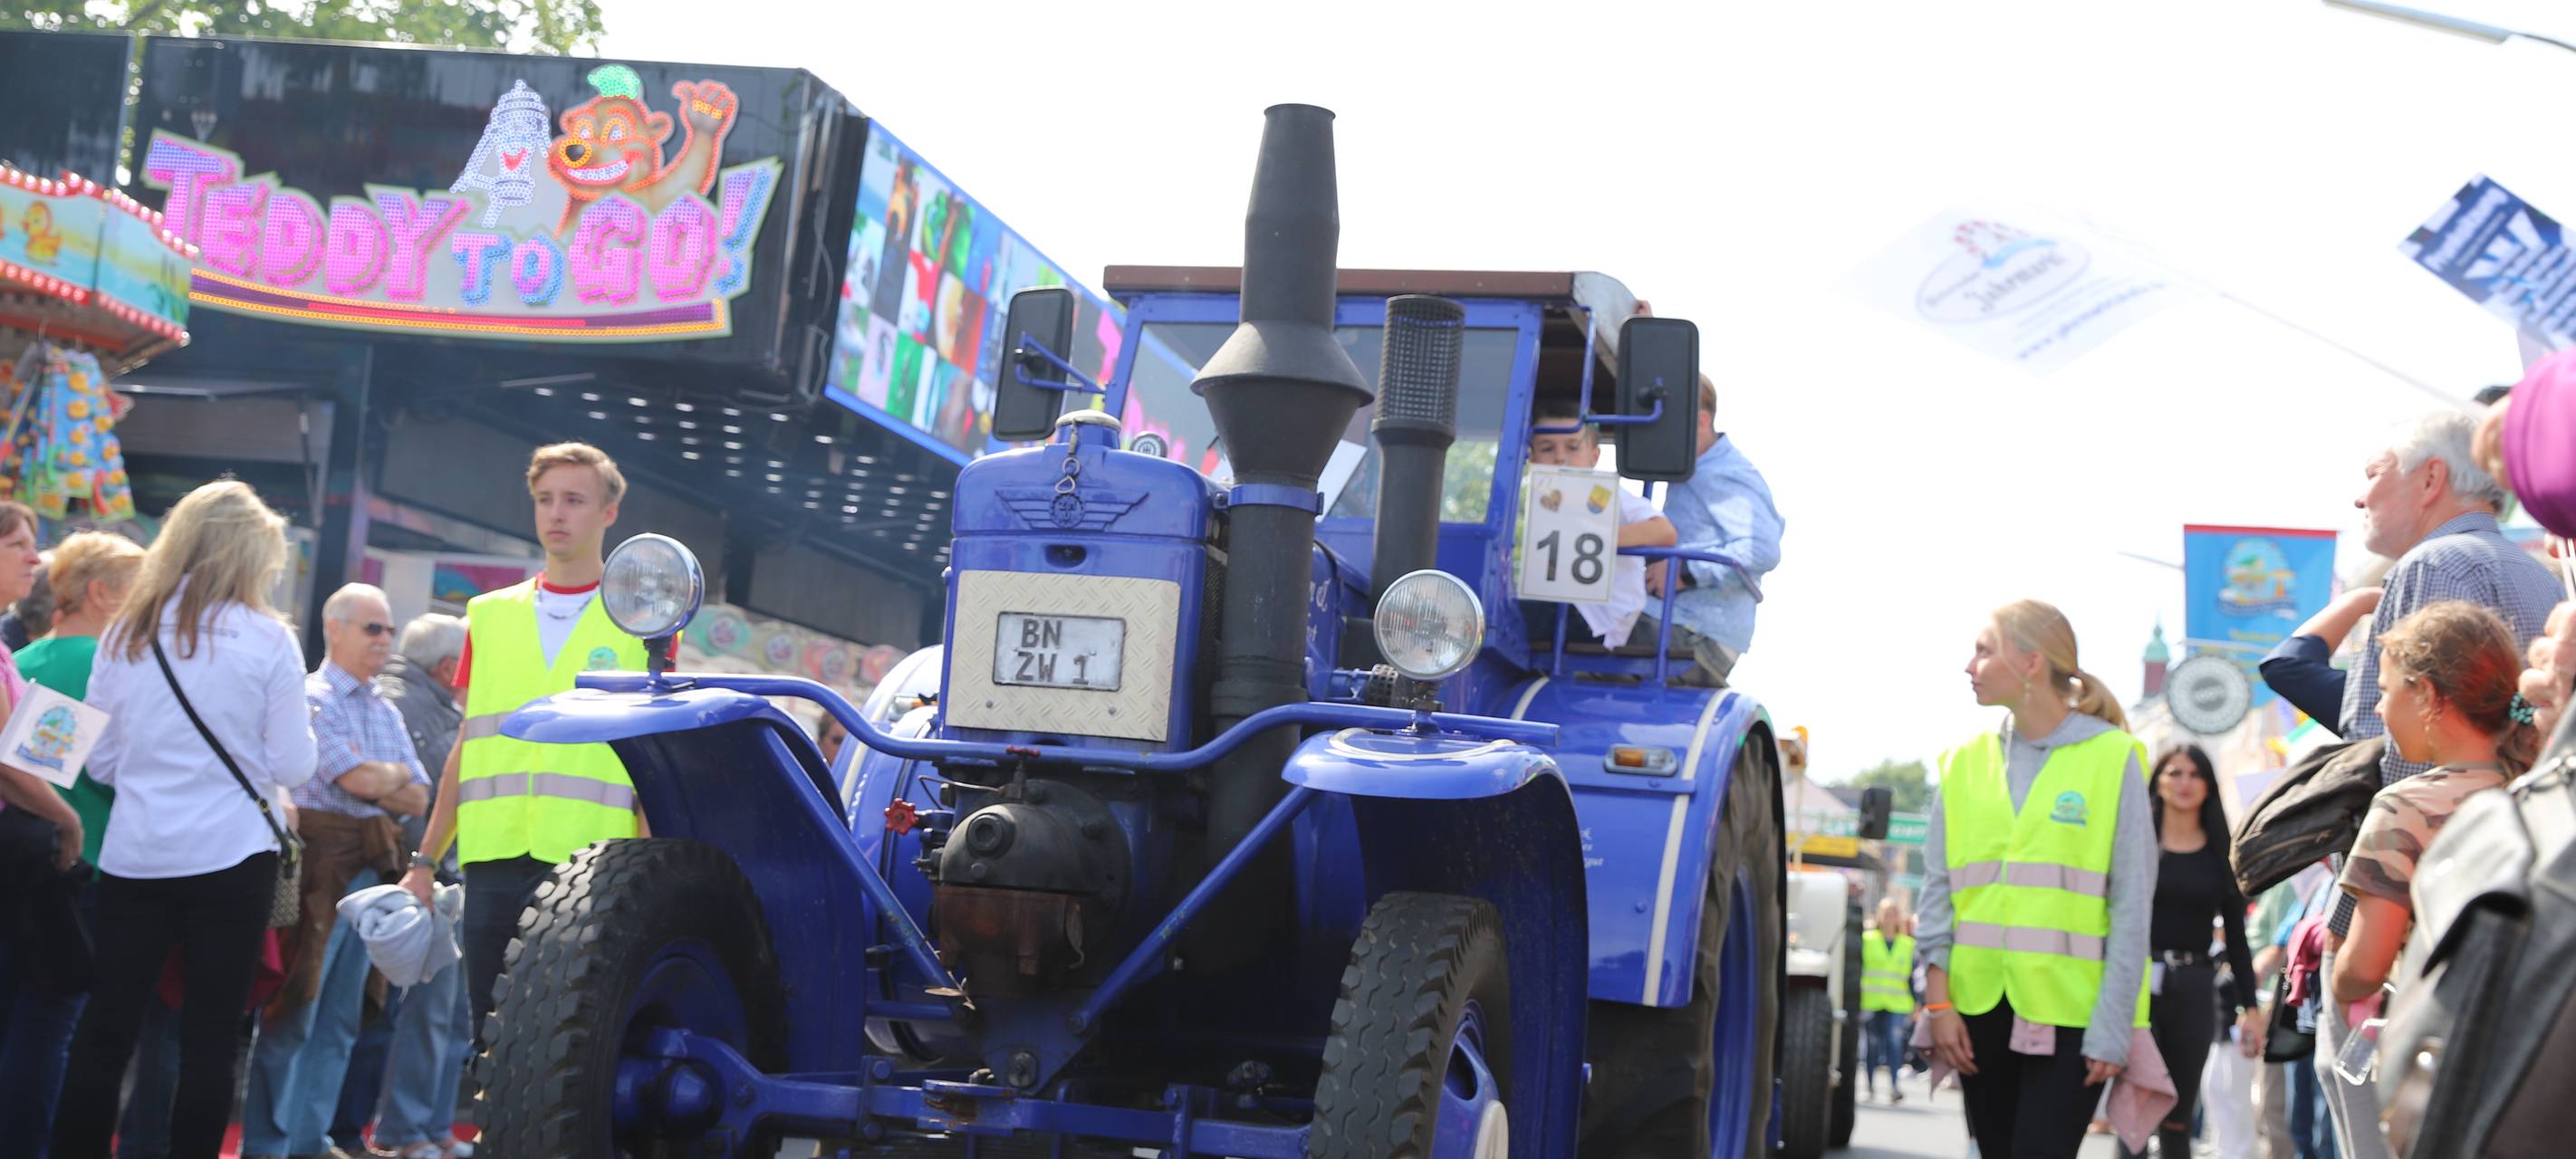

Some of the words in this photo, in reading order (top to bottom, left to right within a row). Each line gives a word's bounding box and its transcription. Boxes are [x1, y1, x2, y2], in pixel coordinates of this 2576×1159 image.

[146, 138, 468, 303] TEDDY
[452, 232, 565, 306] TO
[567, 165, 774, 308] GO!
[1536, 529, 1604, 586] 18
[1020, 618, 1062, 650] BN
[1014, 650, 1058, 683] ZW
[1072, 654, 1090, 685] 1
